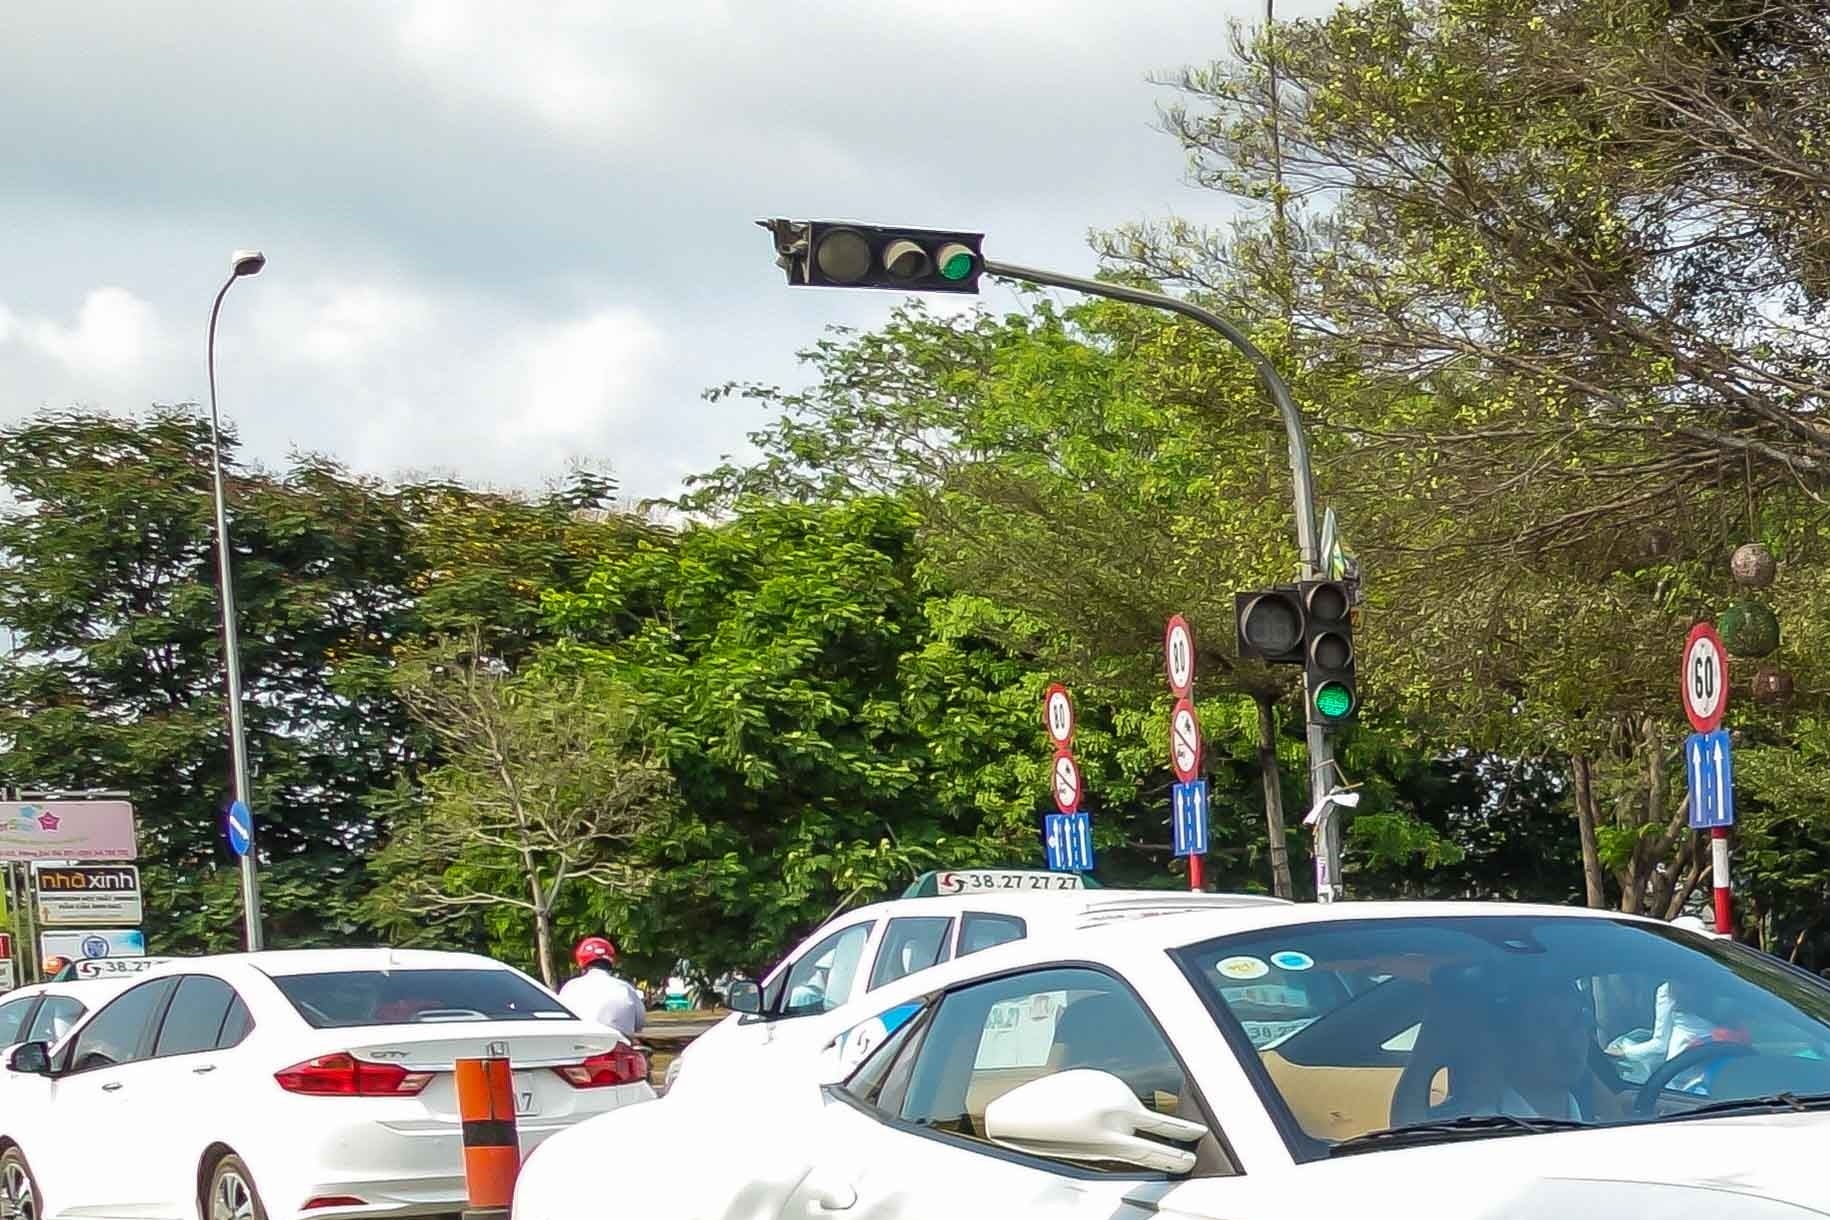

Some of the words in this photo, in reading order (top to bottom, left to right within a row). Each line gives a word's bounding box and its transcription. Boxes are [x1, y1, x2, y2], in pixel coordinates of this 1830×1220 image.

[1695, 655, 1714, 699] 60
[41, 871, 86, 889] nhà
[88, 871, 134, 889] xinh
[1029, 876, 1050, 889] 27
[1057, 877, 1077, 890] 27
